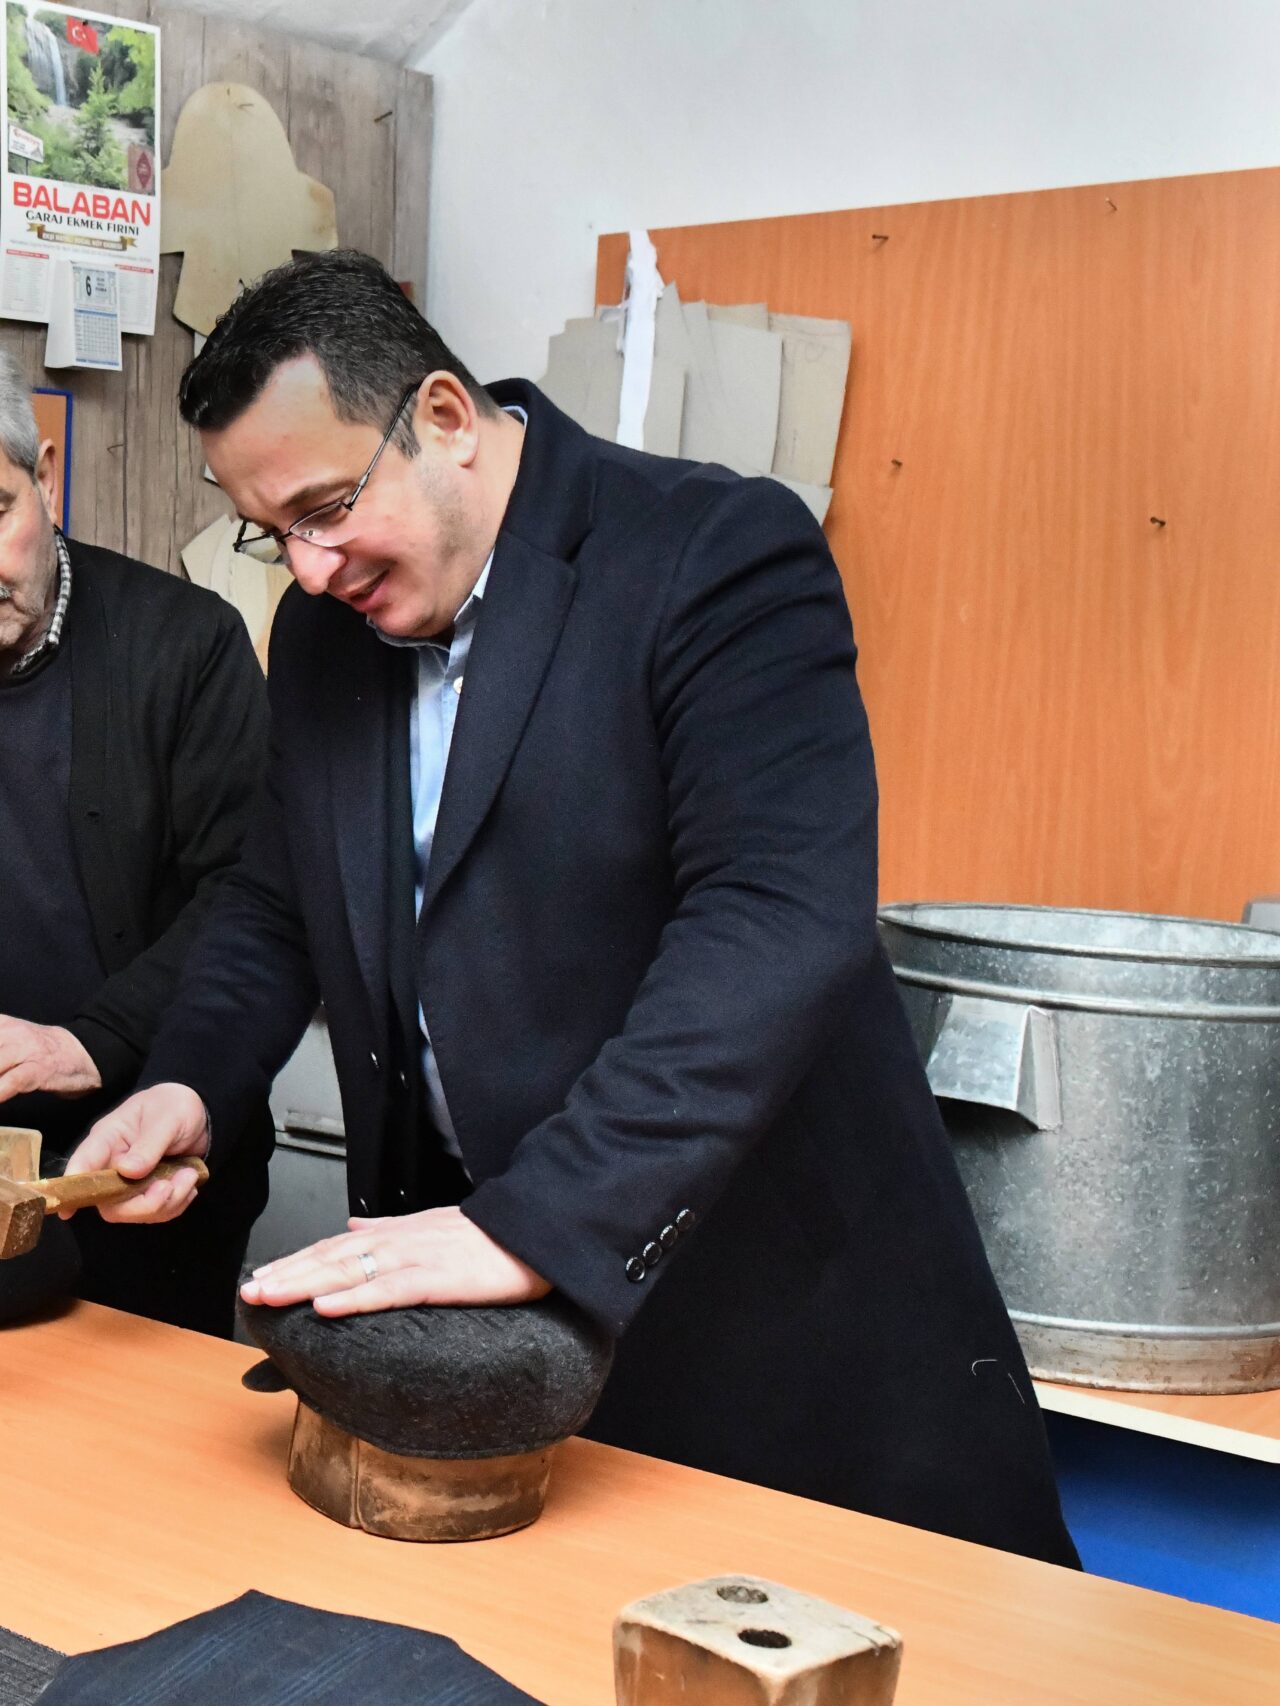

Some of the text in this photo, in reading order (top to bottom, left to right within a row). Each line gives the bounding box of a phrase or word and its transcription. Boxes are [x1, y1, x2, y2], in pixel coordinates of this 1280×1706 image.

[13, 181, 151, 226] BALABAN
[25, 211, 63, 224] GARAJ
[67, 217, 104, 230] EKMEK
[85, 275, 92, 297] 6
